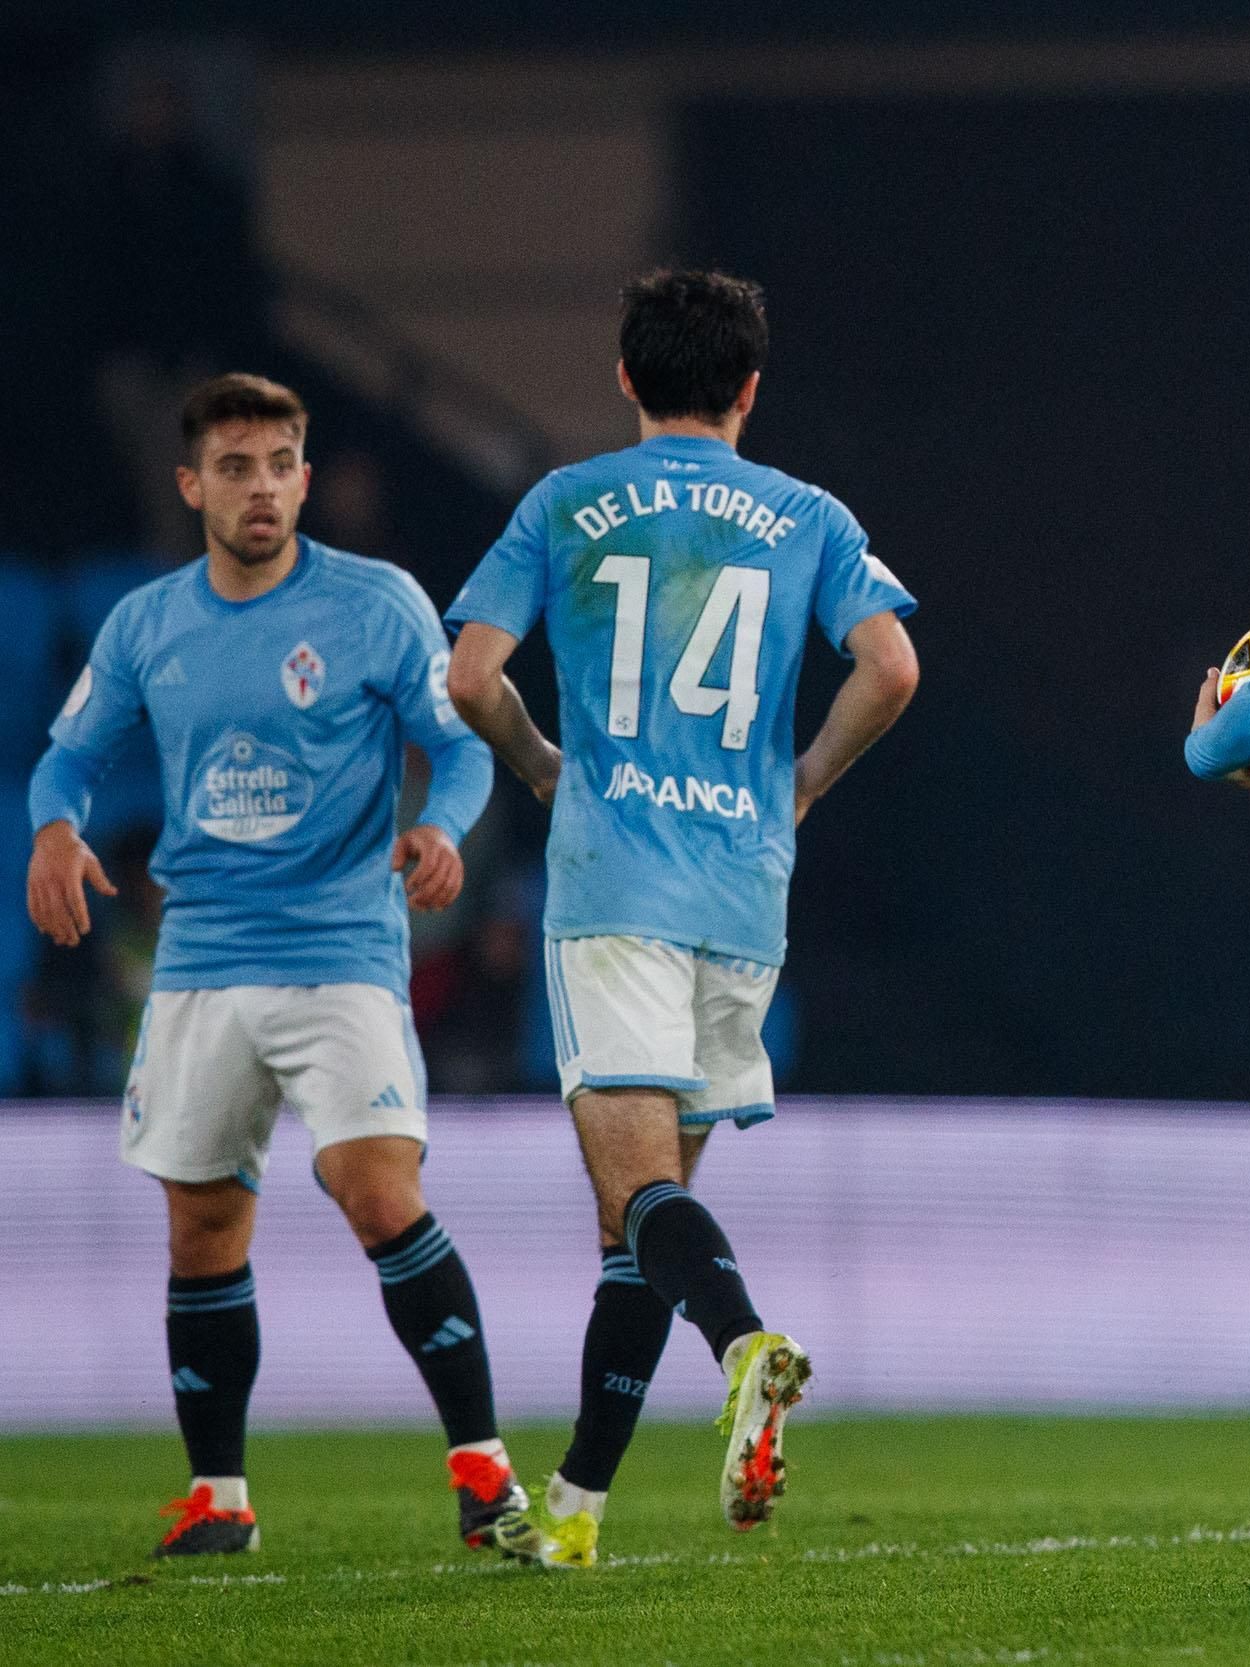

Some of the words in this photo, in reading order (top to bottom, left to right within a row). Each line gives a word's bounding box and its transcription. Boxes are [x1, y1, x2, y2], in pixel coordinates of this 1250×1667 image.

[573, 492, 628, 540] DE
[627, 479, 678, 516] LA
[686, 483, 795, 549] TORRE
[592, 554, 771, 750] 14
[206, 766, 288, 792] Estrella
[208, 790, 288, 817] Galicia
